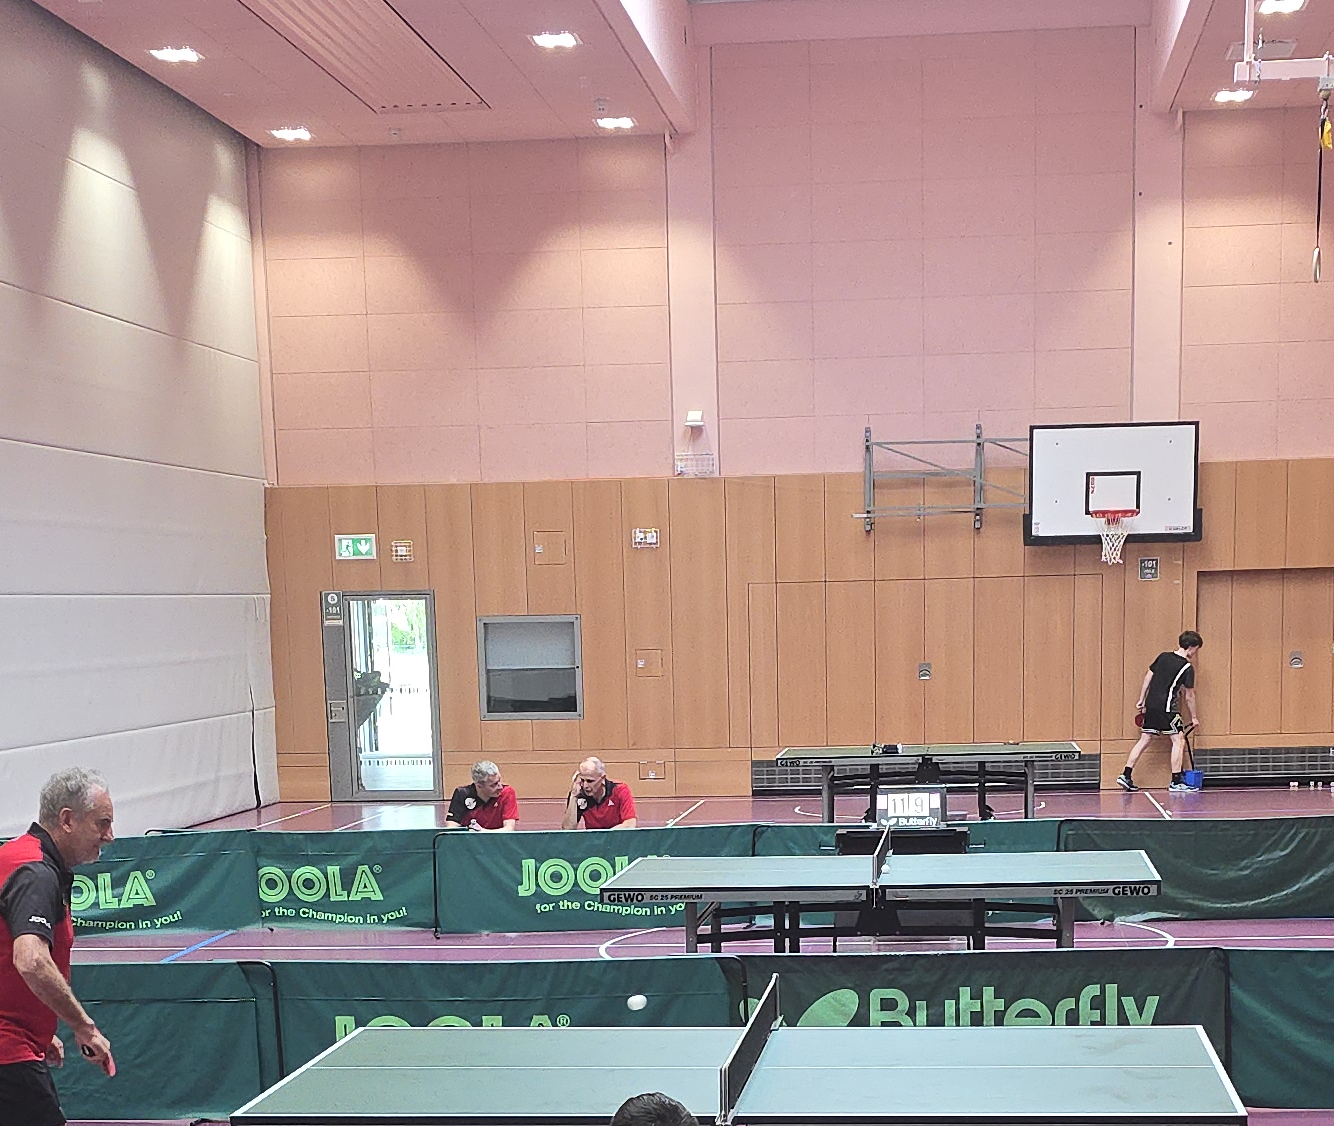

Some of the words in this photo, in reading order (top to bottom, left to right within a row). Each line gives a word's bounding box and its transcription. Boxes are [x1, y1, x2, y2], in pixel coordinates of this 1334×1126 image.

[898, 817, 937, 827] Butterfly
[70, 869, 157, 911] OLA
[257, 864, 384, 903] OOLA
[1111, 885, 1151, 896] GEWO
[607, 892, 645, 903] GEWO
[535, 902, 555, 913] for
[558, 900, 581, 911] the
[584, 901, 651, 916] Champion
[653, 905, 667, 915] in
[274, 906, 296, 917] the
[299, 907, 364, 924] Champion
[366, 913, 379, 924] in
[138, 919, 152, 929] in
